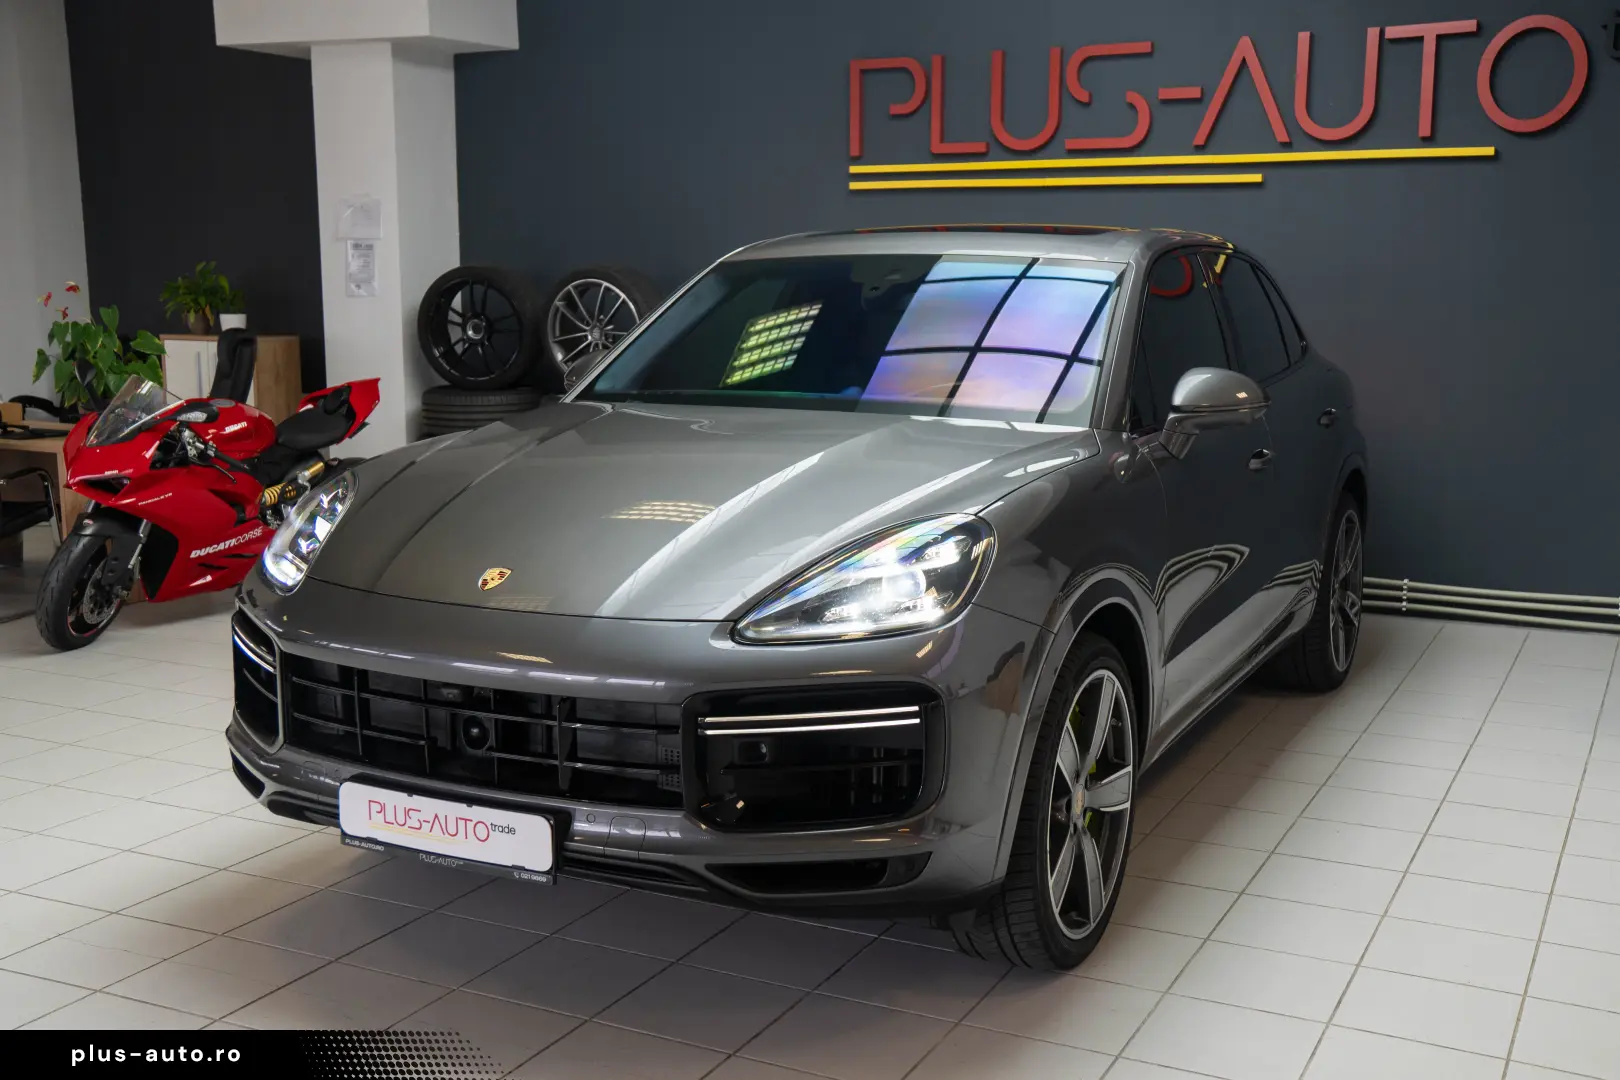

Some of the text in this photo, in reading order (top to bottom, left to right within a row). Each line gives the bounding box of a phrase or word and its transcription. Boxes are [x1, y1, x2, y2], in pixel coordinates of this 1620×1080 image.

[849, 14, 1588, 157] PLUS-AUTO
[368, 799, 516, 843] PLUS-AUTO trade
